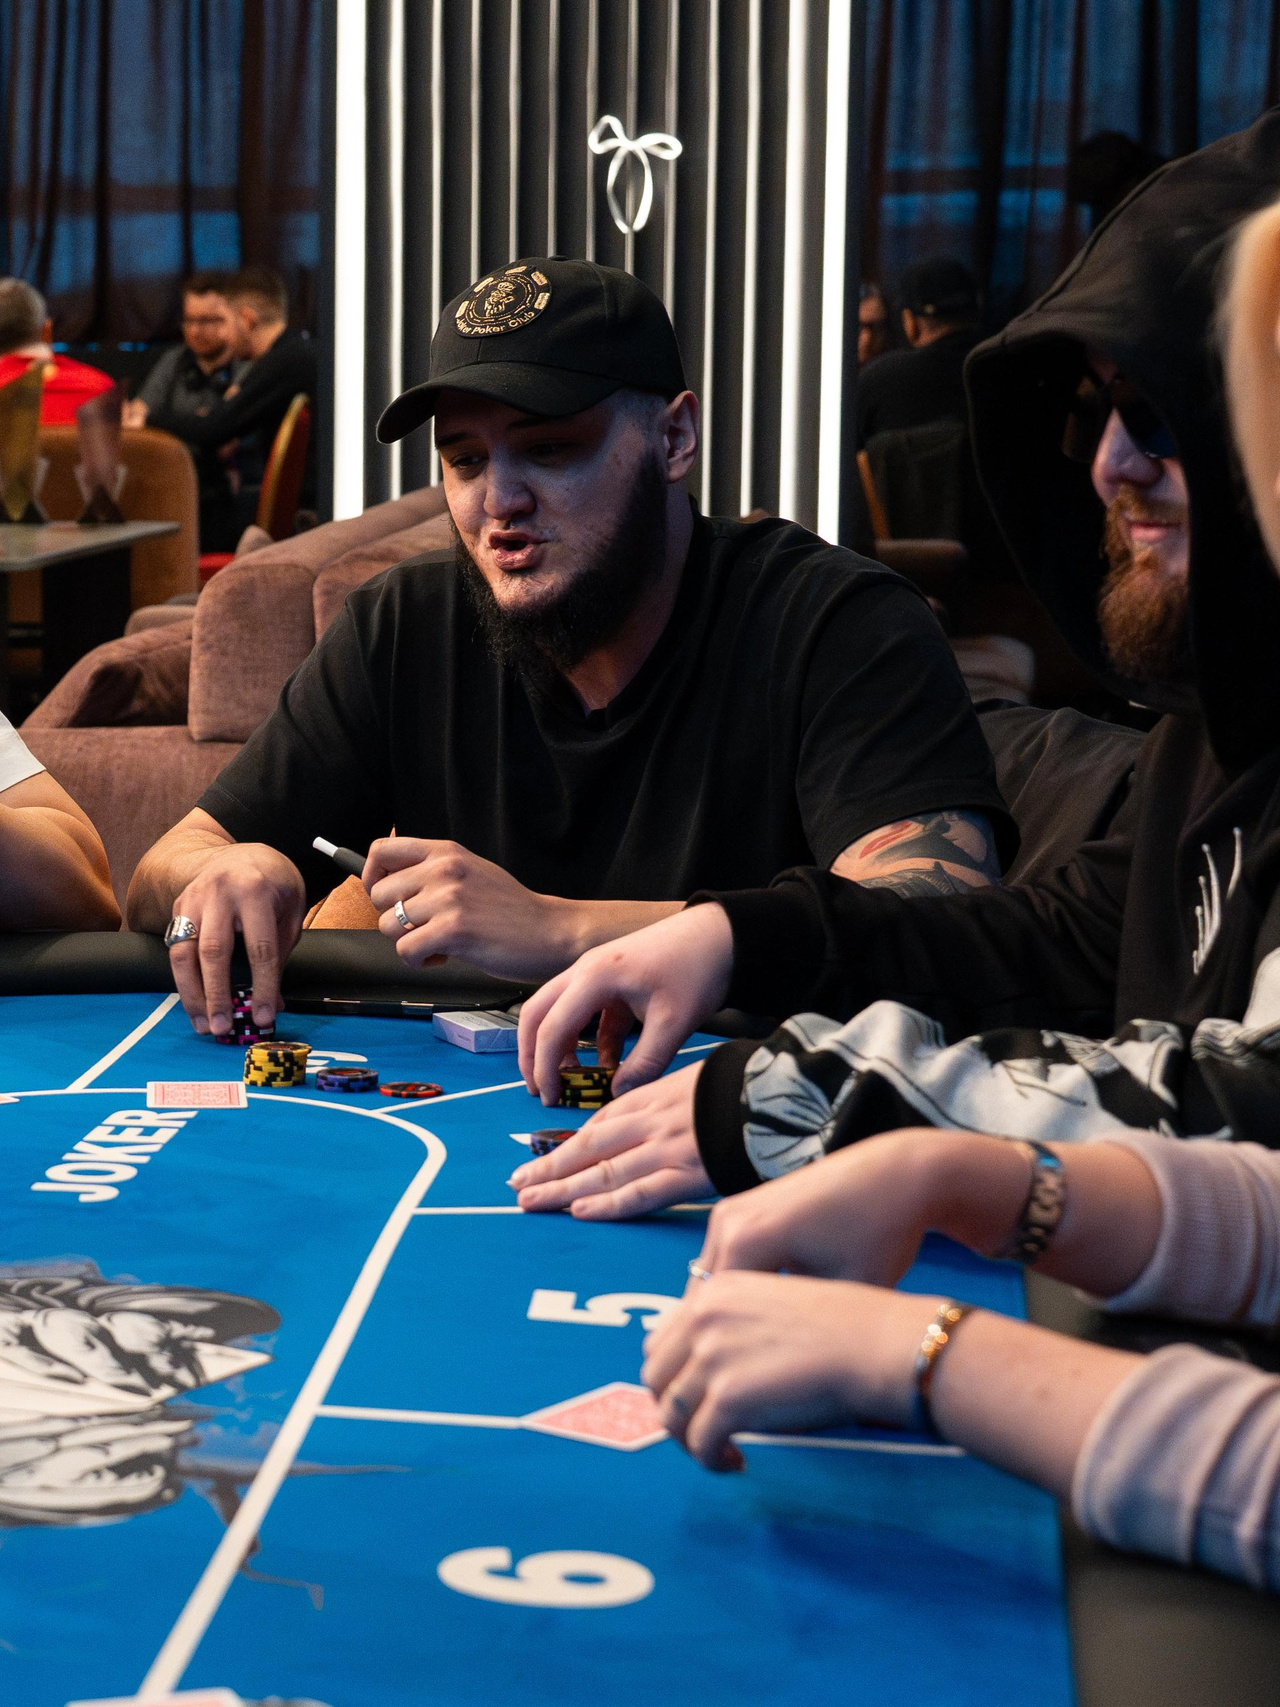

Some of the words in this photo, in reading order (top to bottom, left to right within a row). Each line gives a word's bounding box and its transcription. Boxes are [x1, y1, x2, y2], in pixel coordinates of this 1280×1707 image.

[471, 325, 506, 335] Poker
[508, 311, 535, 328] Club
[31, 1108, 198, 1203] JOKER
[527, 1288, 685, 1330] 5
